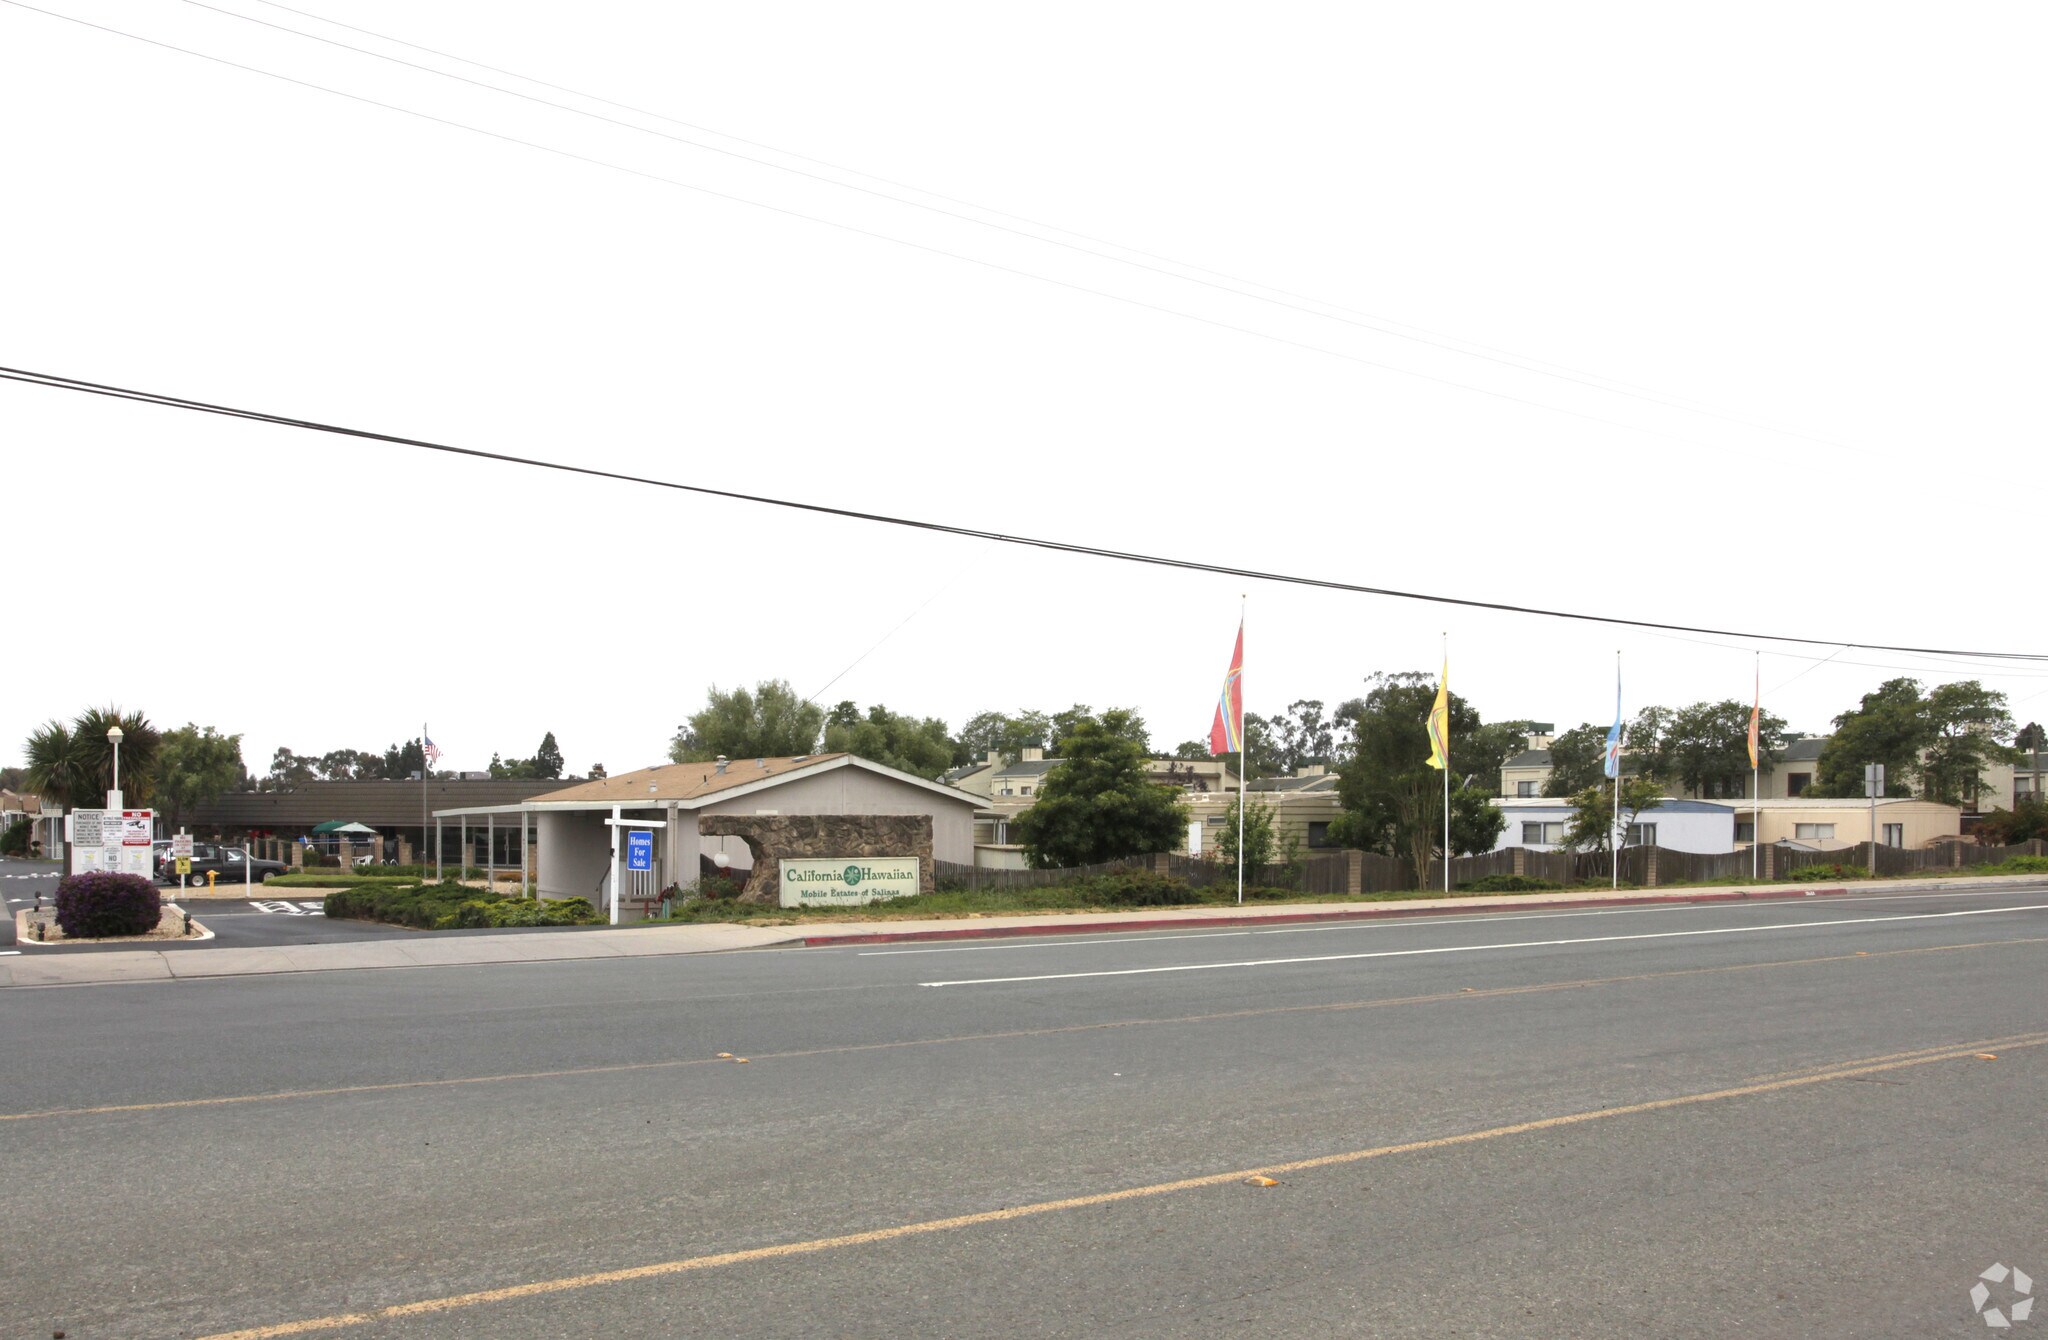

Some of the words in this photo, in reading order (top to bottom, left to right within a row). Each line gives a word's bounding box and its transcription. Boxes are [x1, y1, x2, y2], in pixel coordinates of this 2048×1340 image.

[630, 836, 650, 846] Homes
[634, 847, 645, 856] For
[633, 858, 646, 867] Sale
[787, 869, 844, 882] California
[861, 867, 914, 880] Hawaiian
[801, 890, 827, 898] Mobile
[830, 888, 858, 897] Estates
[872, 888, 899, 896] Salinas
